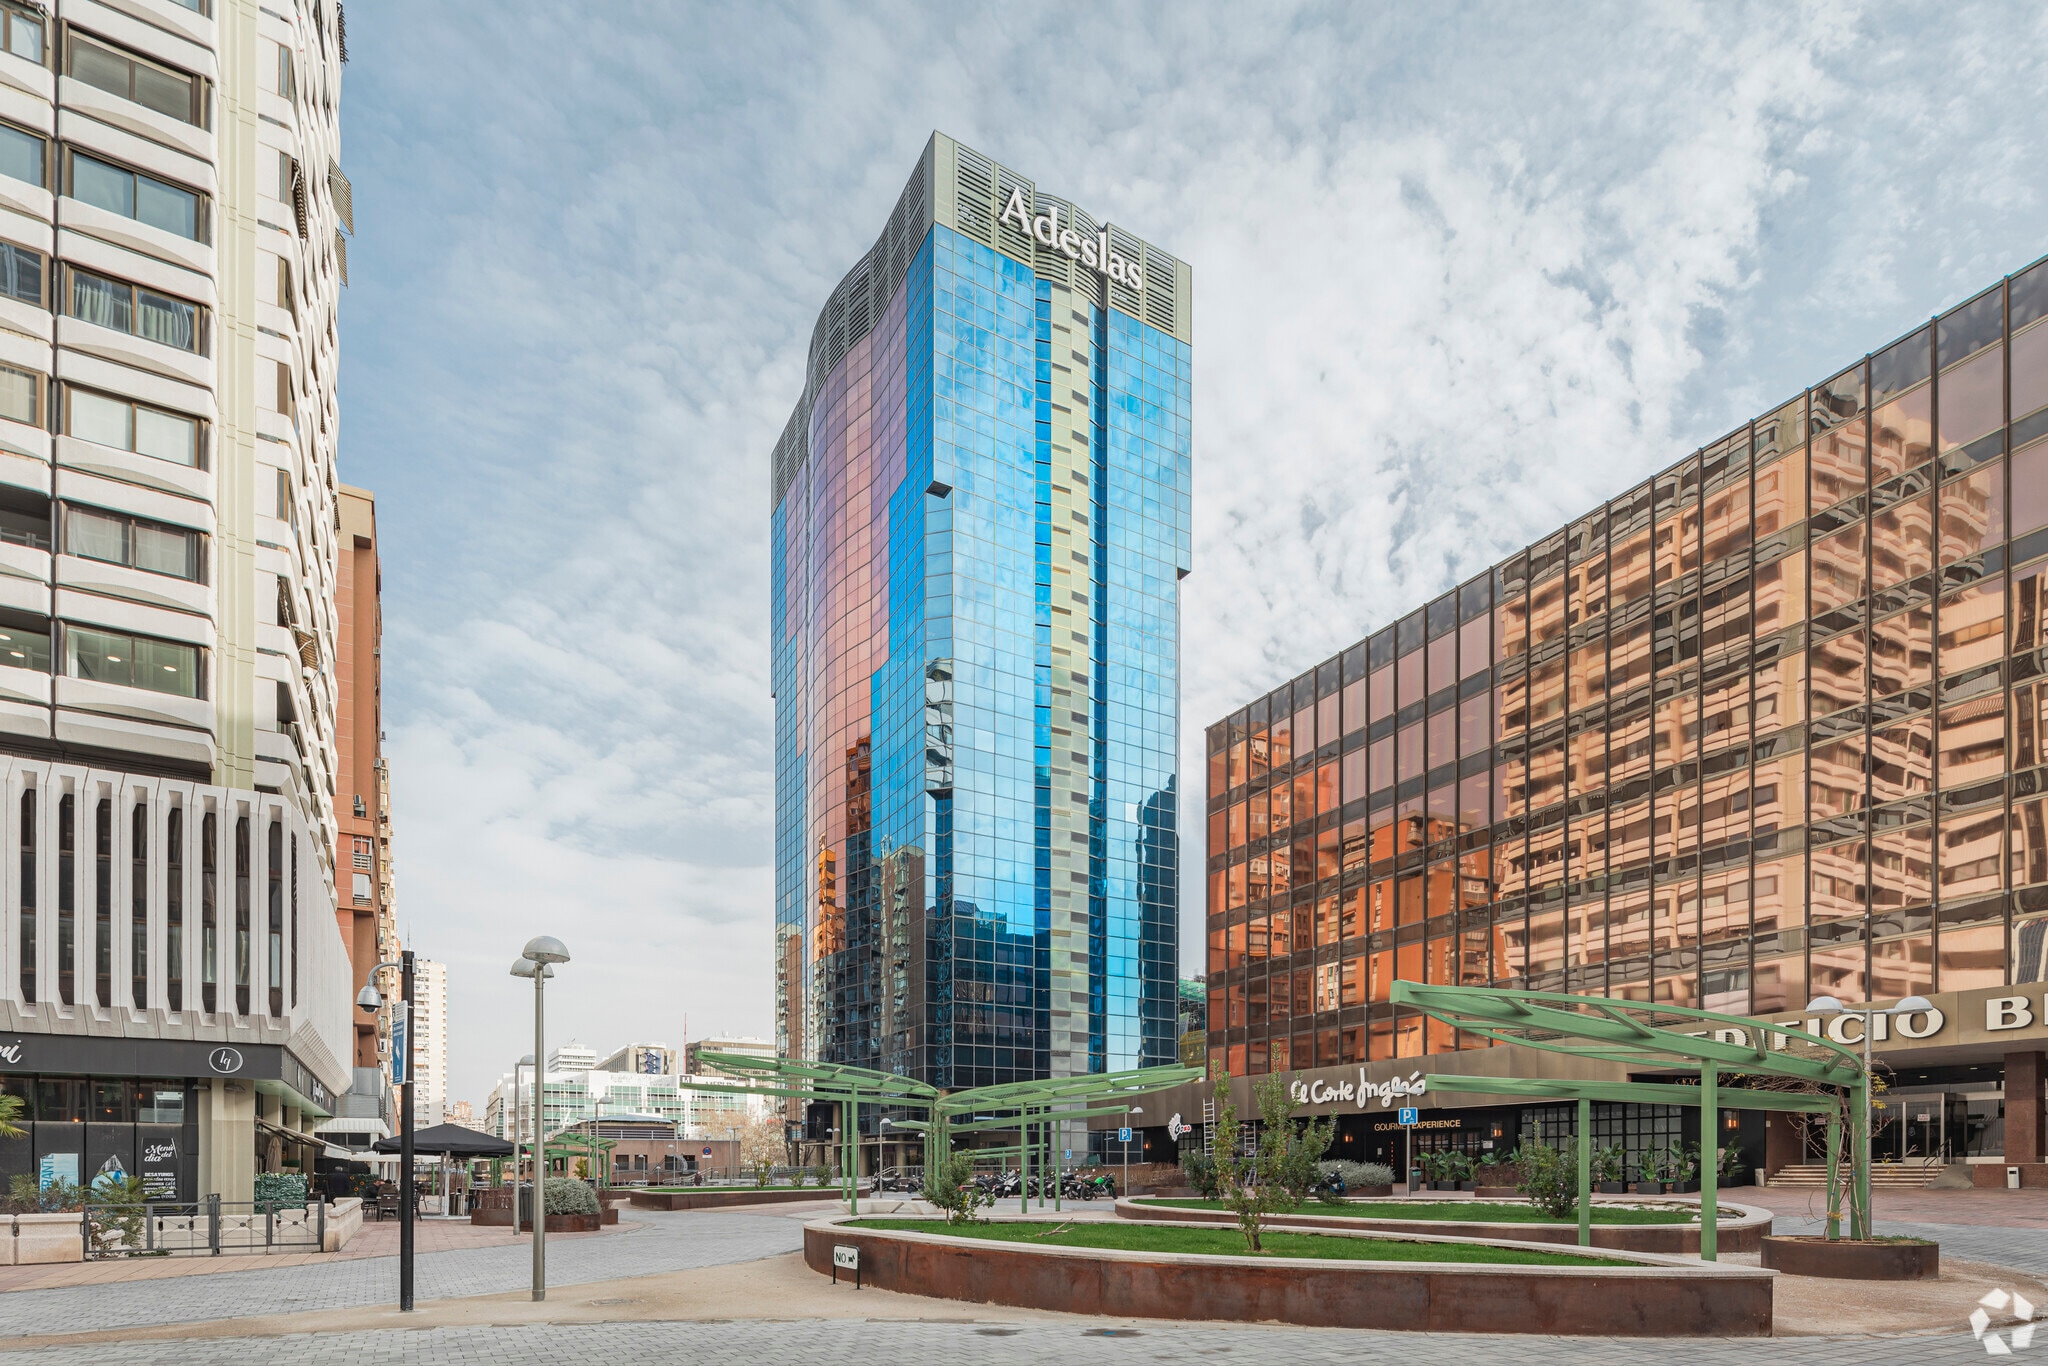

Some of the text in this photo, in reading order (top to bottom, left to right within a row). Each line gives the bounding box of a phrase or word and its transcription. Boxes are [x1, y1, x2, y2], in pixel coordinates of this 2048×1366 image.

[999, 185, 1143, 291] Adeslas
[1683, 1006, 1945, 1059] DFICIO
[1290, 1067, 1426, 1108] El Corte Inglés
[1403, 1109, 1412, 1122] P
[1374, 1119, 1461, 1131] GOURME EXPERIENCE
[1121, 1129, 1128, 1140] P
[835, 1252, 847, 1264] NO
